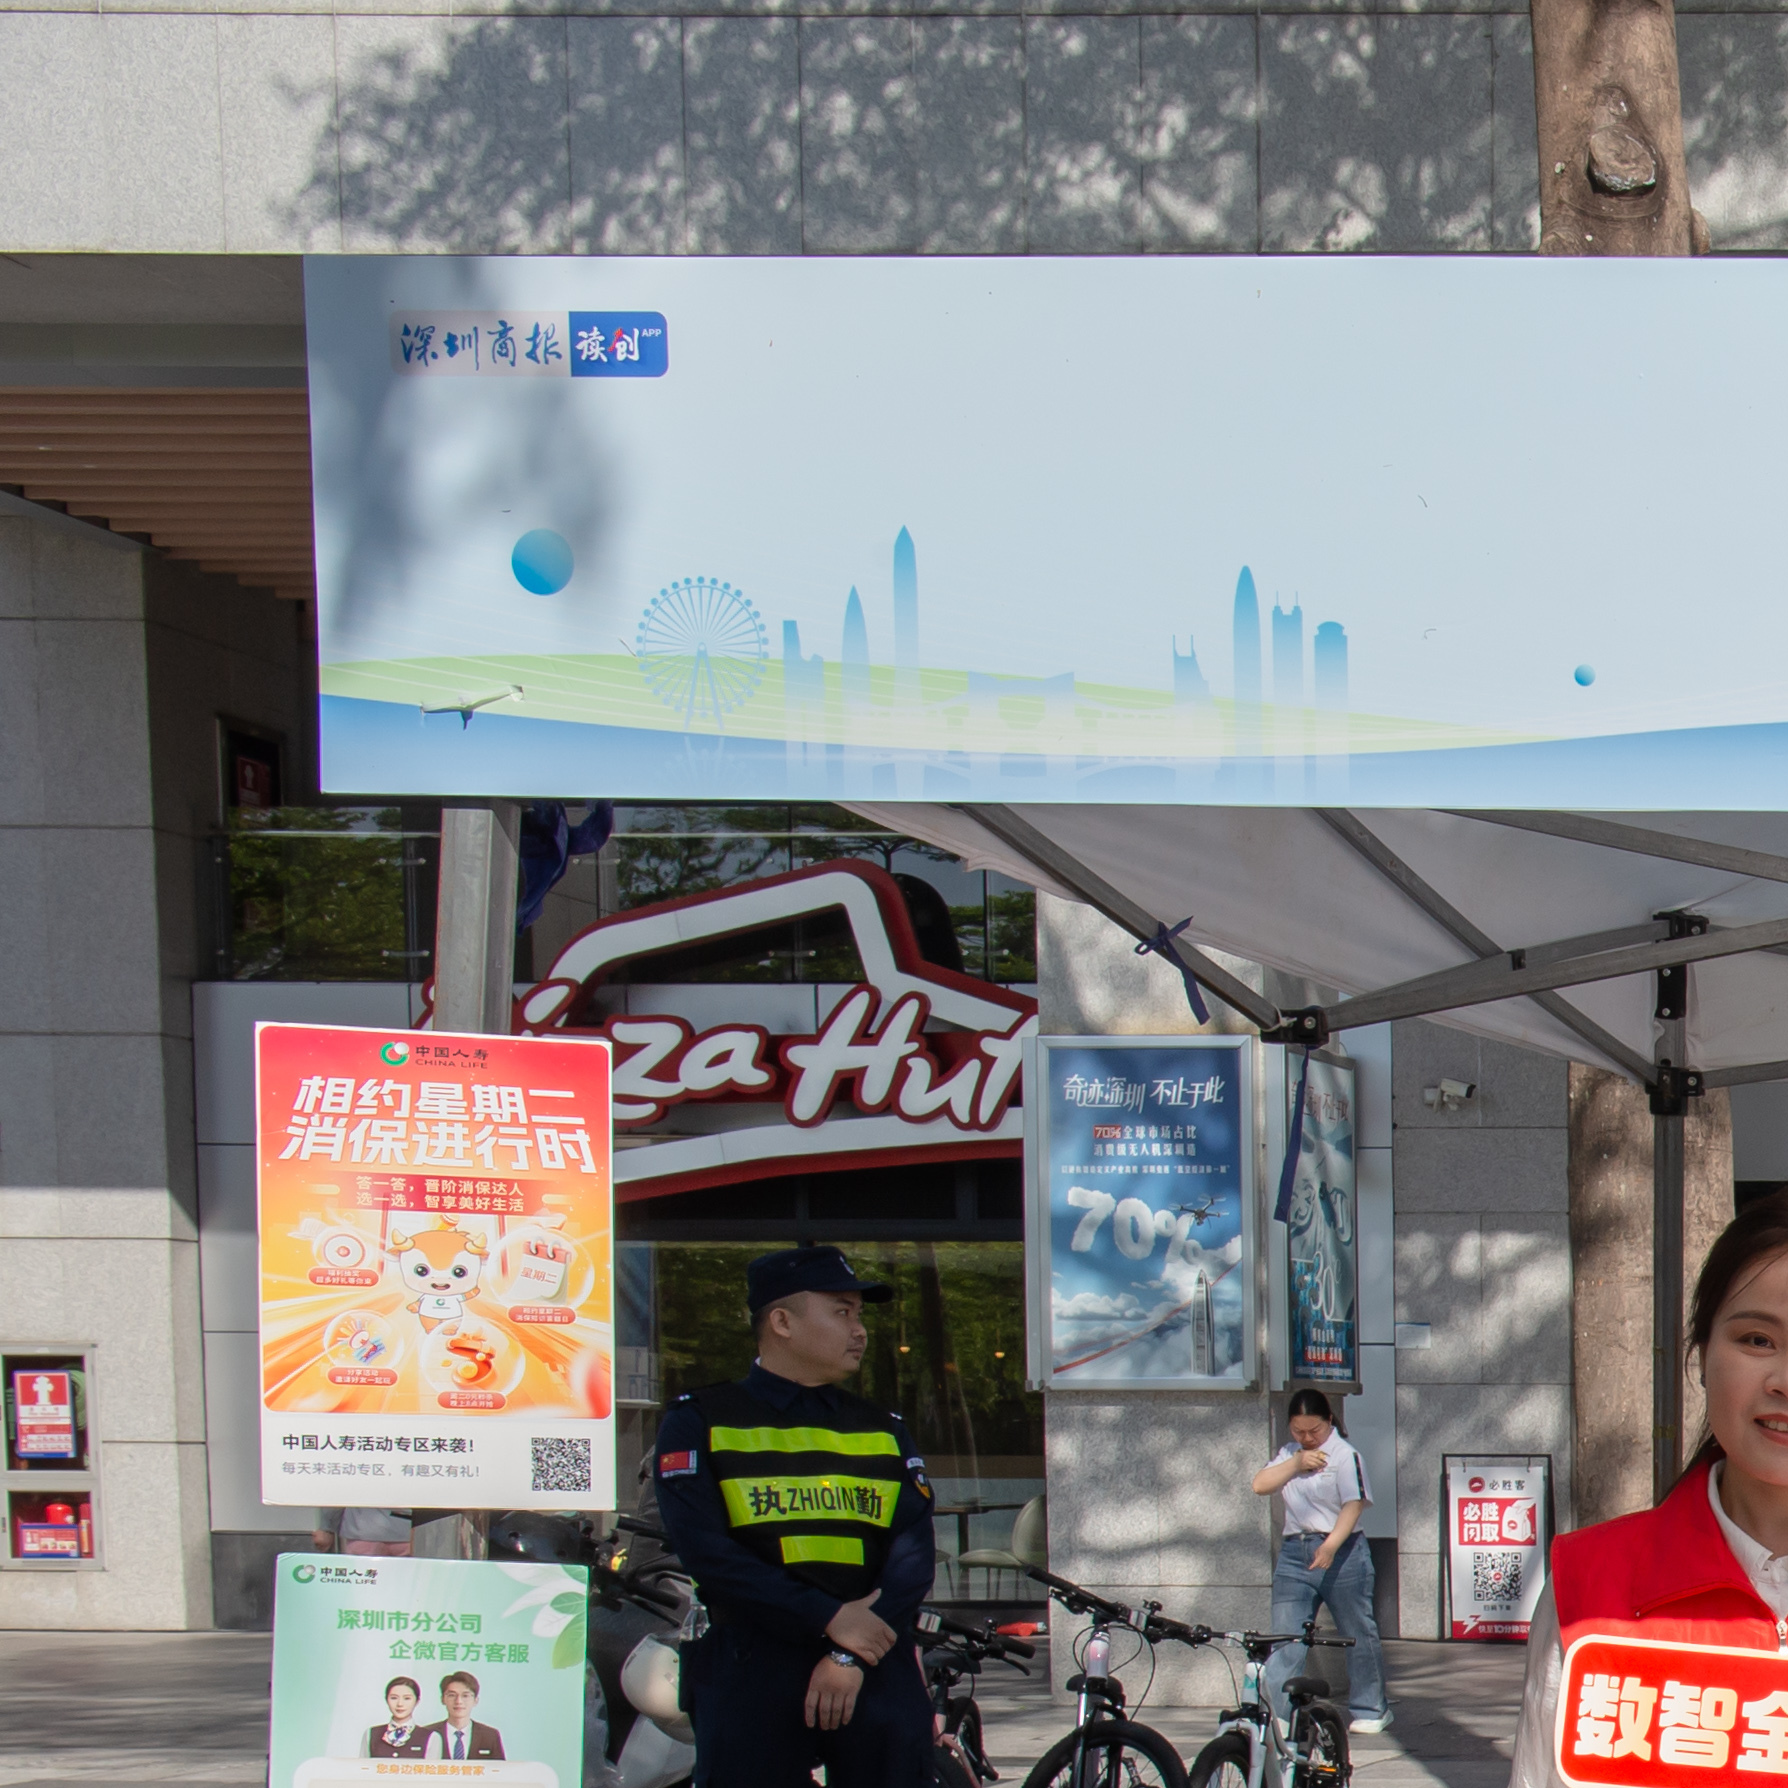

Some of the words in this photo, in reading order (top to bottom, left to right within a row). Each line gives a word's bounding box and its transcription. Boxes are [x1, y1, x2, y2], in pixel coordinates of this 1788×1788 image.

[642, 328, 662, 337] APP
[400, 320, 562, 371] 深圳商报
[576, 327, 640, 363] 读创
[415, 1044, 489, 1061] 中国人寿
[415, 1058, 457, 1068] CHINA
[460, 1060, 488, 1069] LIFE
[293, 1075, 586, 1125] 相约星期二
[1150, 1075, 1226, 1109] 不止于此
[278, 1114, 597, 1173] 消保进行时
[356, 1175, 524, 1197] 答一答，晋阶消保达人
[356, 1191, 524, 1213] 选一选，智享美好生活
[1067, 1186, 1203, 1265] 70%
[520, 1266, 557, 1284] 星期二
[282, 1434, 474, 1453] 中国人寿活动专区来袭！
[282, 1461, 481, 1478] 每天来活动专区，有趣又有礼！
[1489, 1479, 1526, 1491] 必胜客
[1463, 1502, 1500, 1521] 必胜
[320, 1567, 379, 1579] 中国人寿
[320, 1577, 353, 1585] CHINA
[337, 1609, 482, 1634] 深圳市分公司
[389, 1639, 530, 1663] 企微官方客服
[376, 1763, 485, 1776] 您身边保险服务管家
